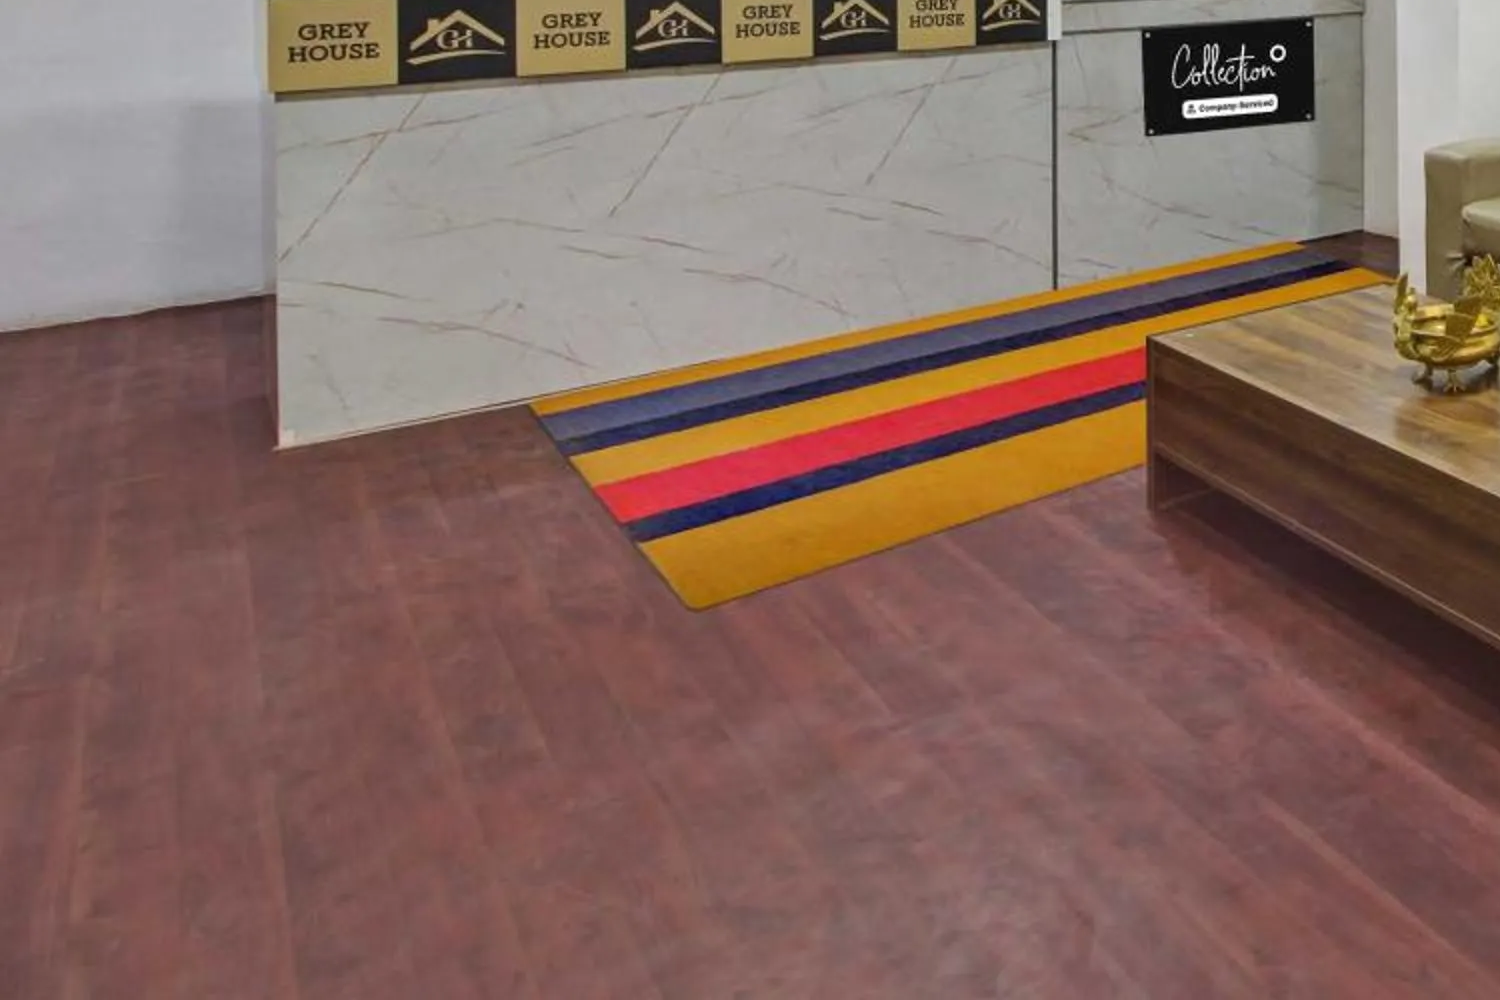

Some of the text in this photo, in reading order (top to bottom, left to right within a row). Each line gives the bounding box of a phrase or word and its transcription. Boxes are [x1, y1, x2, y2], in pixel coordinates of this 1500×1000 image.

[541, 12, 602, 29] GREY
[743, 4, 794, 20] GREY
[909, 13, 965, 29] HOUSE
[298, 22, 370, 41] GREY
[735, 22, 801, 39] HOUSE
[533, 31, 611, 49] HOUSE
[287, 43, 380, 63] HOUSE
[1171, 43, 1277, 92] Collection
